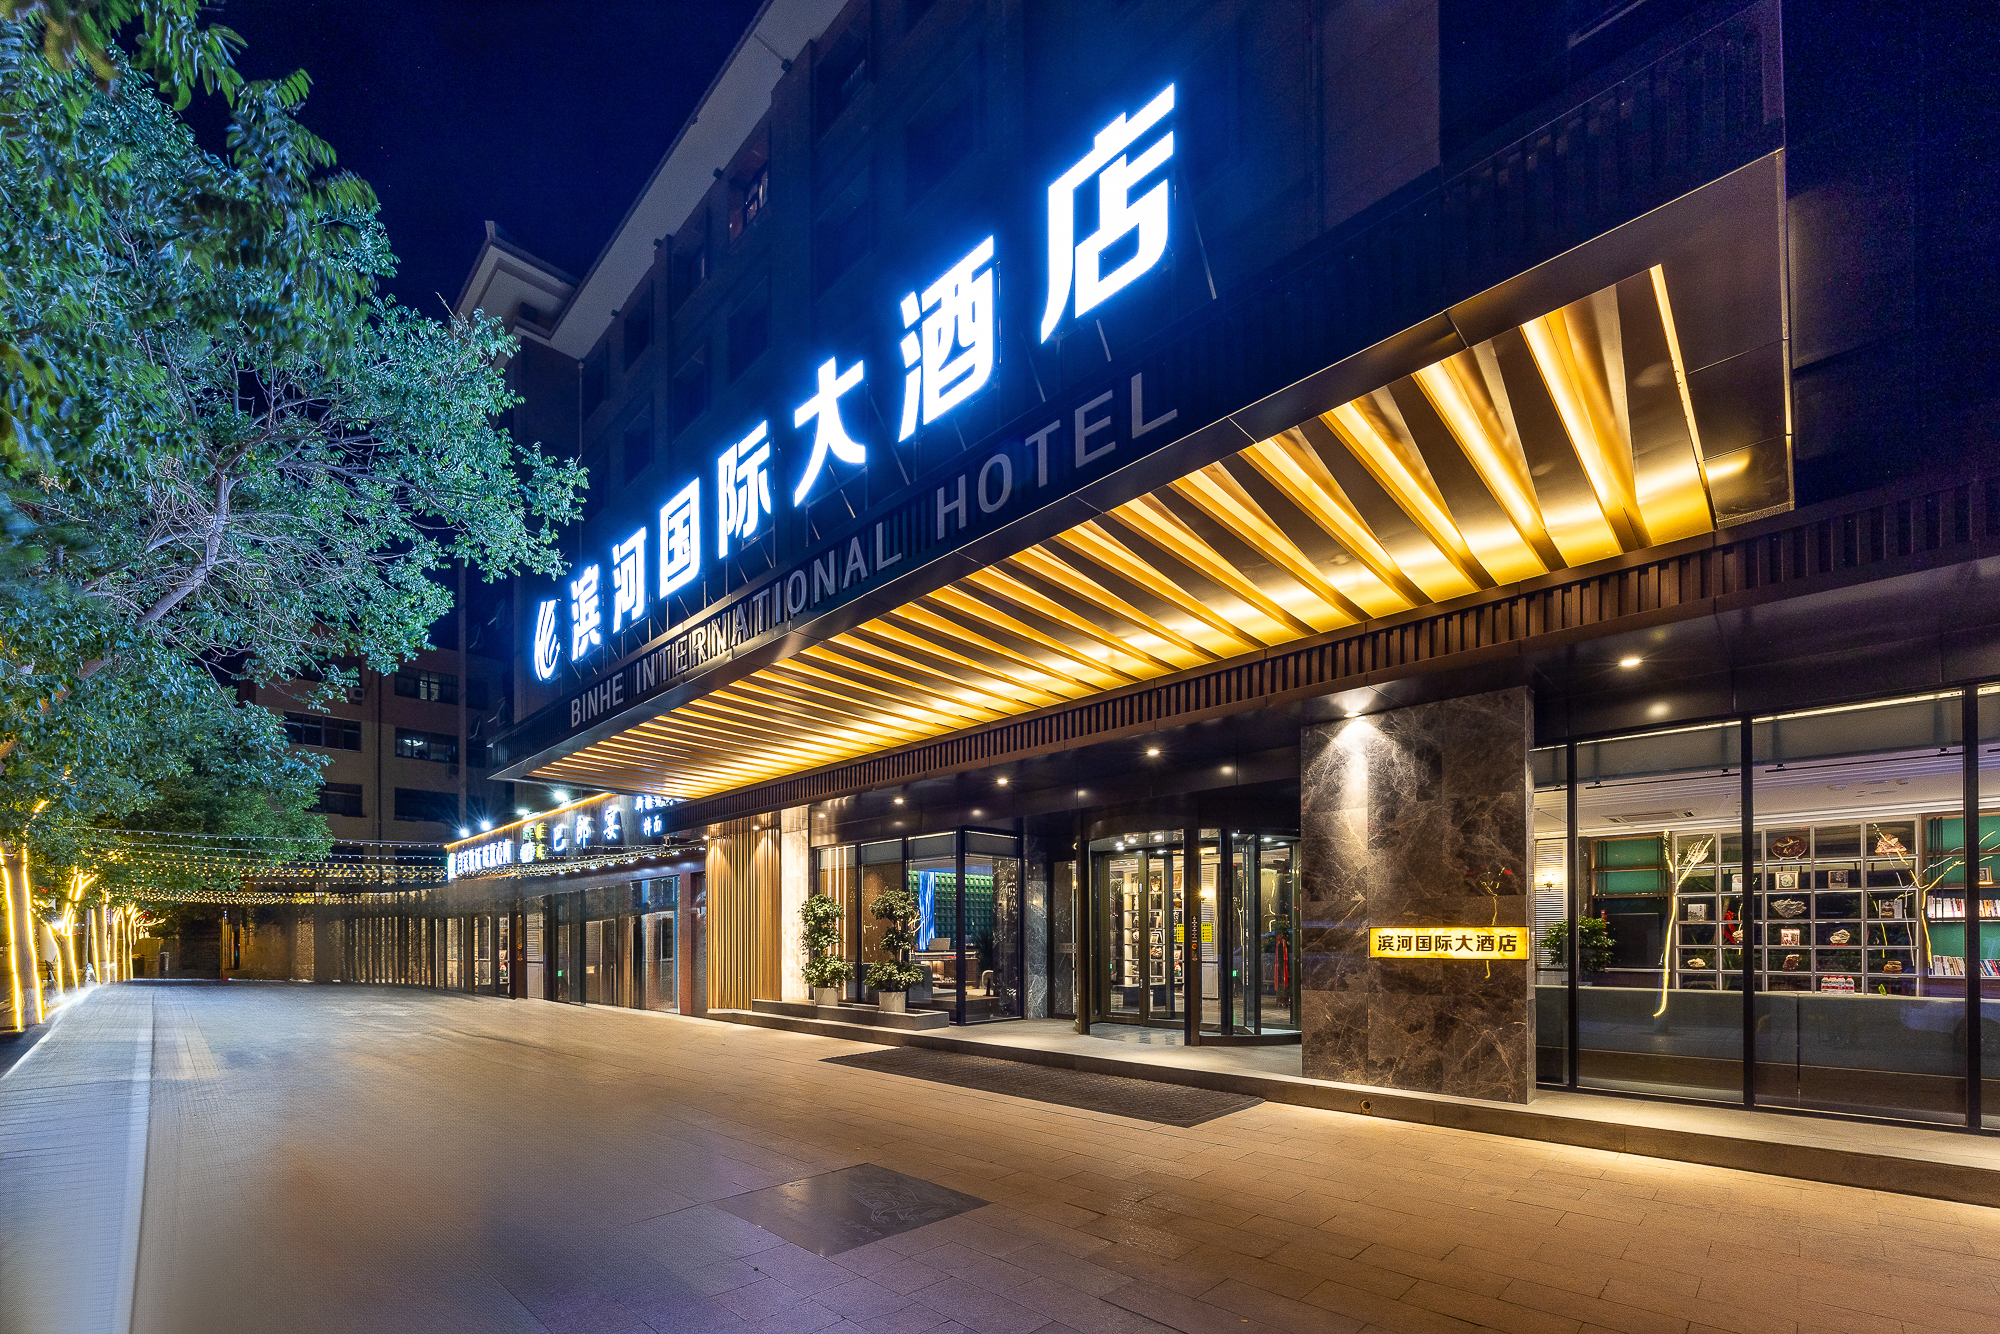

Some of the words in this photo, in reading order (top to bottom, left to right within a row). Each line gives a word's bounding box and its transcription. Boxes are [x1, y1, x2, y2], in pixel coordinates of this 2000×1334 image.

[570, 82, 1175, 663] 滨河国际大酒店
[571, 672, 624, 728] BINHE
[636, 522, 902, 695] INTERNATIONAL
[937, 372, 1178, 540] HOTEL
[1377, 934, 1518, 952] 滨河国际大酒店
